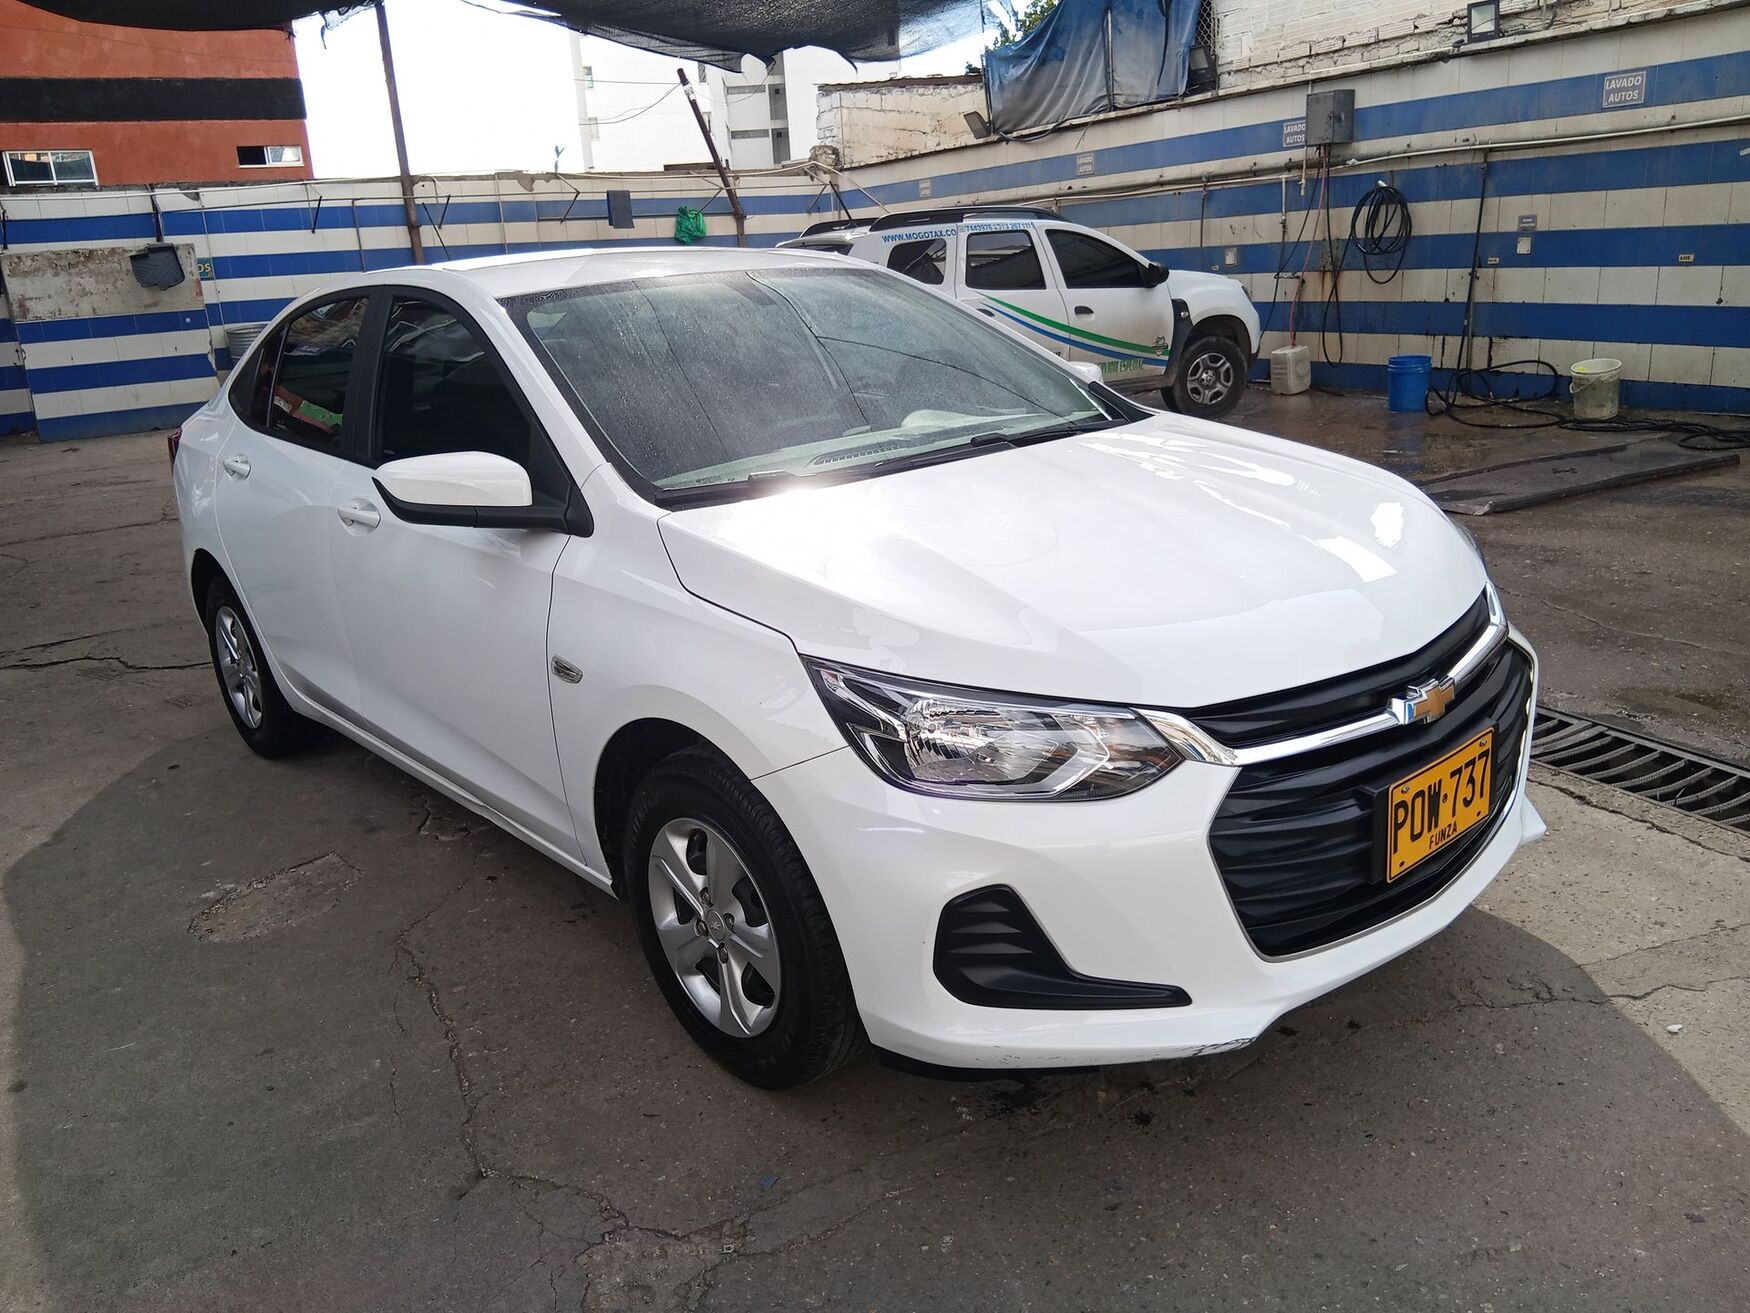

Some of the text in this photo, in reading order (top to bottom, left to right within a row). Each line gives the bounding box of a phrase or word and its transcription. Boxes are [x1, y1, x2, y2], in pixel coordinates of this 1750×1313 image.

[1605, 76, 1642, 90] LAVADO
[1608, 90, 1639, 103] AUTOS
[1284, 123, 1306, 133] LAVADO
[1286, 134, 1305, 144] AUTOS
[1429, 820, 1458, 850] FUNZA
